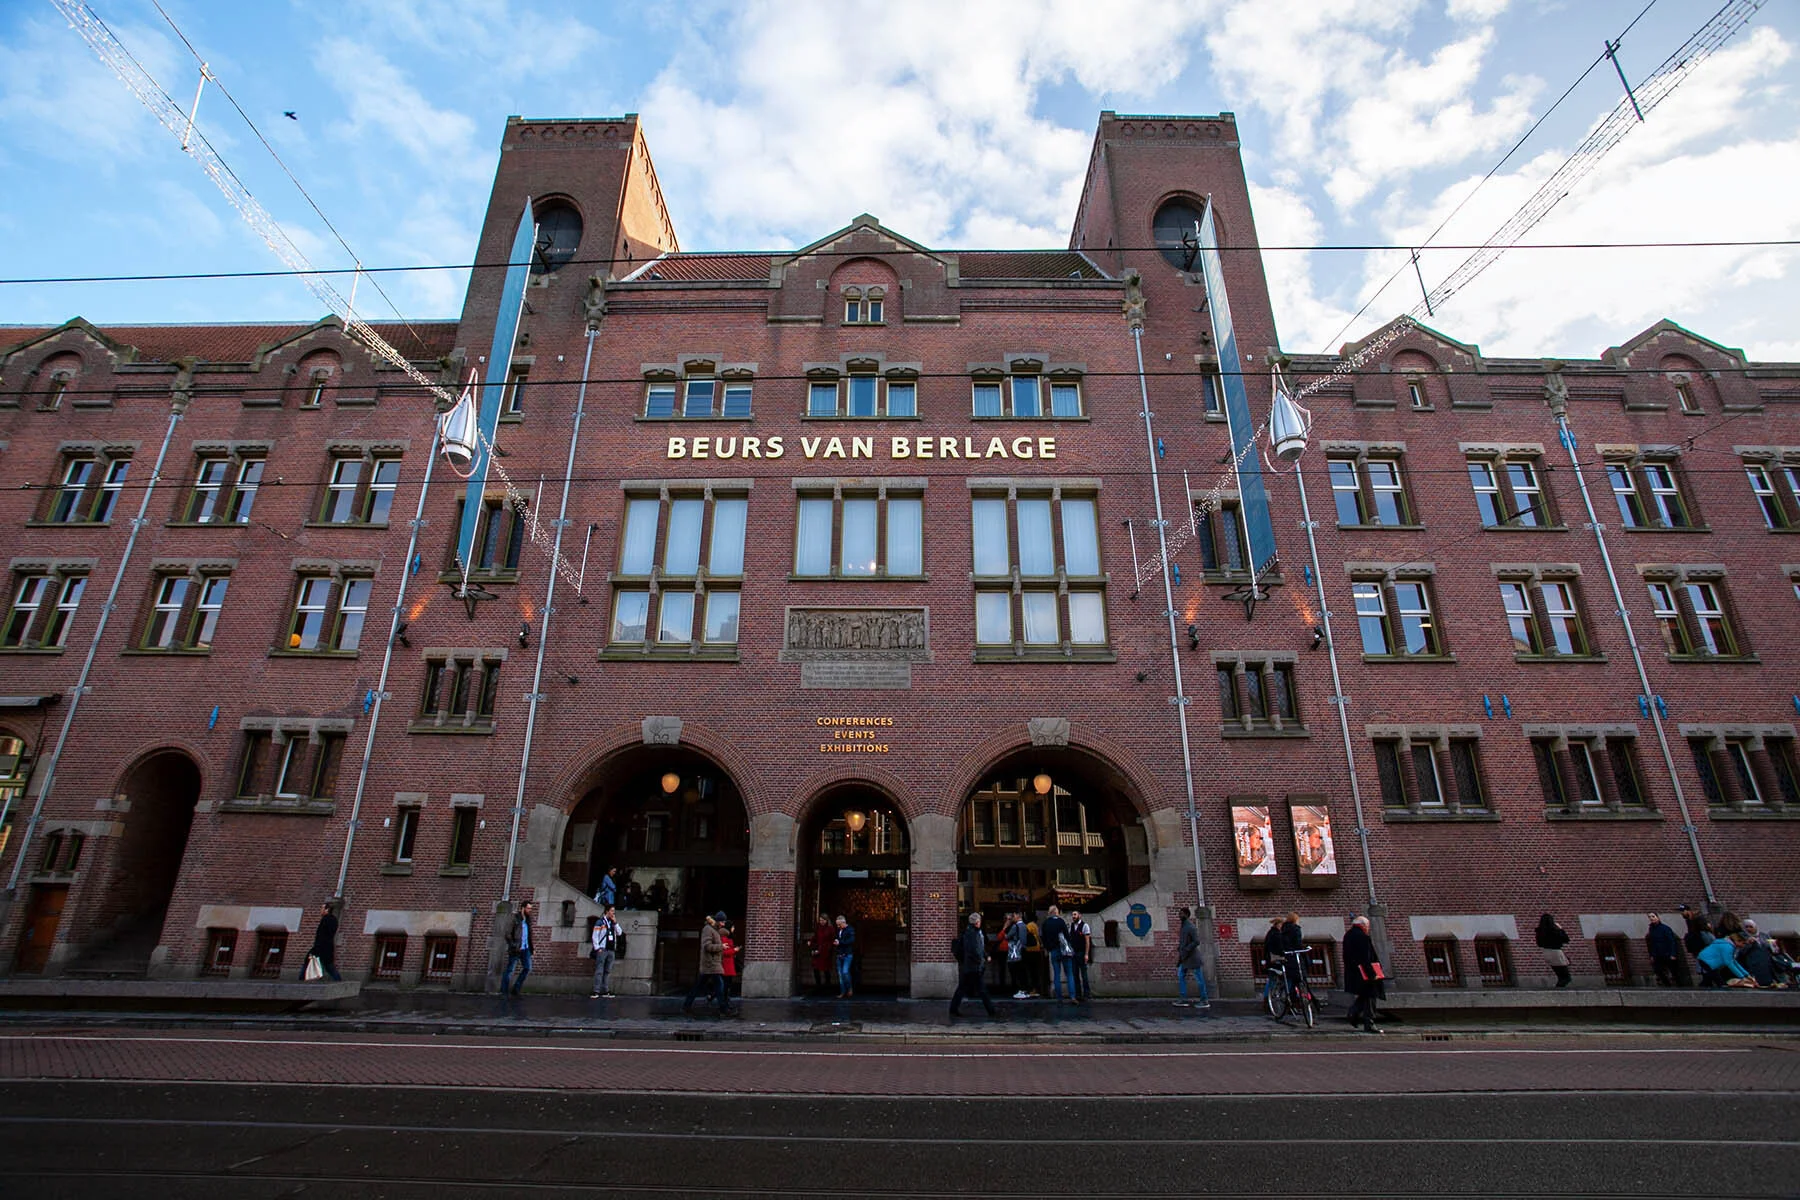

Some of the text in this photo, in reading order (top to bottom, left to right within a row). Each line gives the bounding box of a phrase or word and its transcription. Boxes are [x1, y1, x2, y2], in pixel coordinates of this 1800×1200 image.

[667, 436, 1057, 459] BEURS VAN BERLAGE
[816, 717, 893, 726] CONFERENCES
[834, 730, 876, 739] EVENTS
[820, 743, 889, 753] EXHIBITIONS
